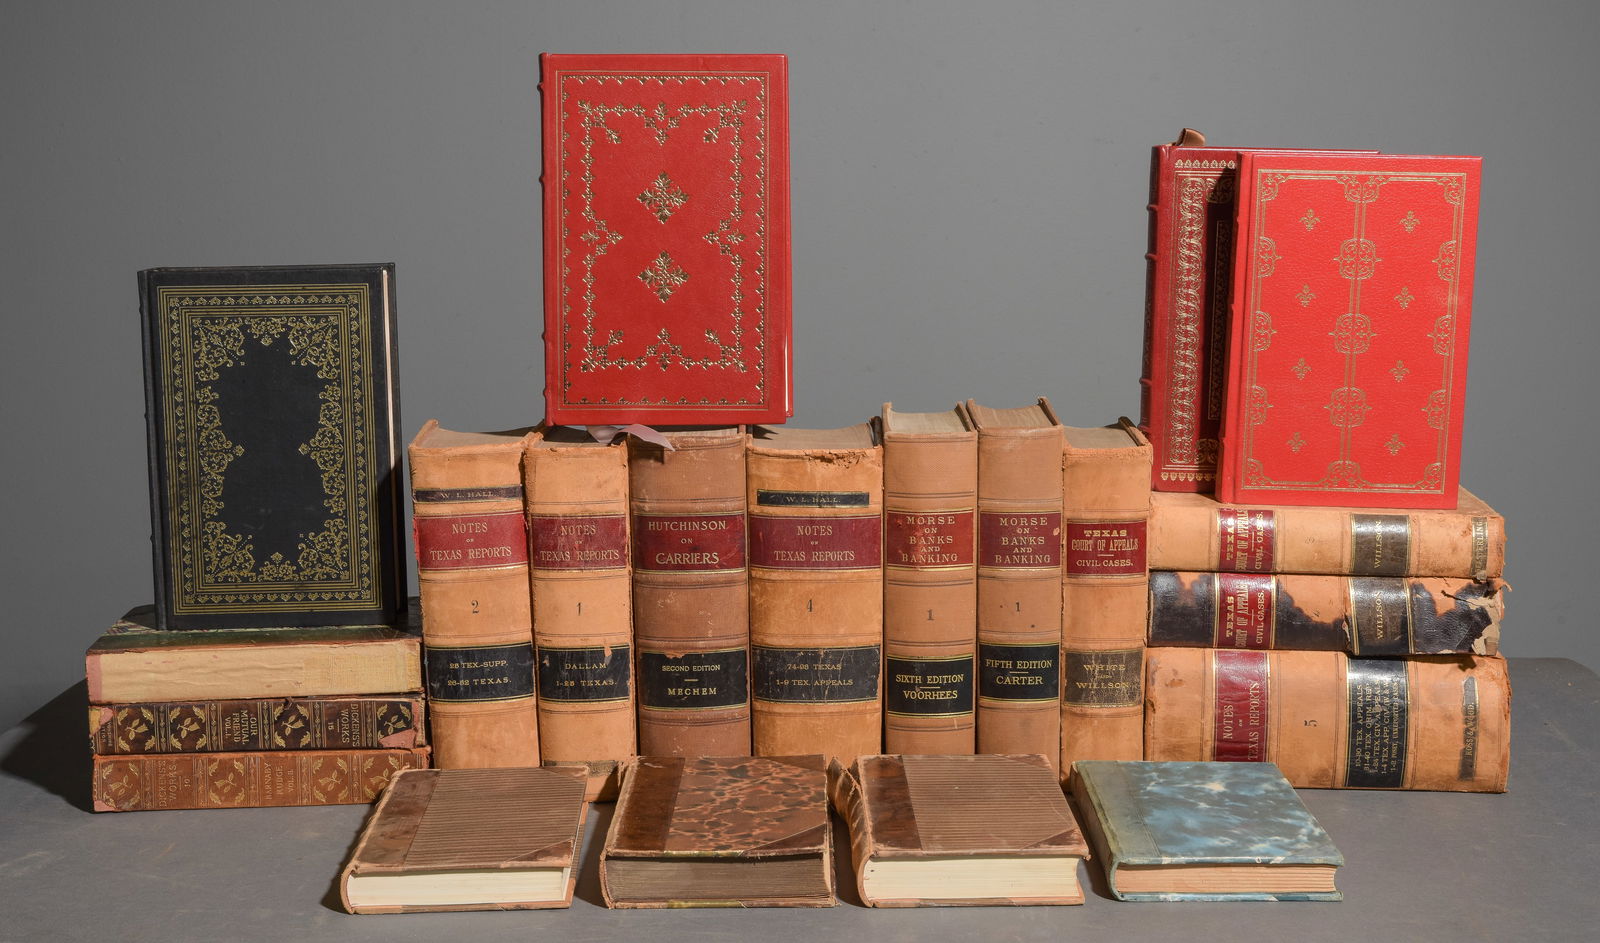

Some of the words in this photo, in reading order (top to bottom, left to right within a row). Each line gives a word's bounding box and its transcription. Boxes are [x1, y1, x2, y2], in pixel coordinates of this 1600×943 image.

[648, 520, 726, 532] HUTCHINSON
[906, 516, 955, 525] MORSE
[1000, 517, 1048, 526] MORSE
[1236, 510, 1248, 538] APPEALS
[452, 522, 488, 534] NOTES
[561, 524, 596, 536] NOTES
[797, 525, 833, 536] NOTES
[909, 536, 953, 544] BANKS
[1002, 536, 1045, 545] BANKS
[1072, 539, 1094, 551] COURT
[1097, 540, 1106, 550] OF
[1108, 538, 1138, 551] APPEALS
[1236, 540, 1248, 549] OF
[1374, 520, 1382, 568] WILLSON
[430, 550, 462, 561] TEXAS
[468, 546, 512, 559] REPORTS
[540, 550, 571, 561] TEXAS
[576, 549, 620, 560] REPORTS
[656, 552, 720, 565] CARRIERS
[774, 550, 806, 562] TEXAS
[811, 550, 855, 562] REPORTS
[902, 553, 958, 562] BANKING
[995, 554, 1051, 563] BANKING
[1255, 546, 1263, 570] CIVIL
[1235, 552, 1248, 571] COURT
[807, 599, 813, 612] 4
[1236, 584, 1248, 614] APPEALS
[1256, 590, 1264, 621] CASES.
[471, 600, 480, 614] 2
[576, 602, 582, 616] 1
[1015, 602, 1020, 612] 1
[927, 609, 934, 620] 1
[1374, 591, 1384, 639] WILLSON
[1236, 617, 1248, 626] OF
[1235, 630, 1247, 648] COURT
[1256, 622, 1264, 644] CIVIL
[986, 659, 1012, 669] FIFTH
[1016, 659, 1052, 668] EDITION
[896, 674, 922, 683] SIXTH
[927, 674, 964, 683] EDITION
[996, 676, 1043, 685] CARTER
[668, 687, 717, 696] MECHEM
[904, 690, 958, 700] VOORHEES
[1249, 682, 1260, 726] REPORTS
[233, 713, 241, 742] FRIEND
[341, 709, 350, 743] WORKS
[351, 704, 359, 747] DICKENS'S
[1223, 704, 1234, 739] NOTES
[1304, 719, 1317, 727] 5
[1248, 732, 1259, 760] TEXAS
[158, 760, 167, 807] DICKENS'S
[168, 764, 177, 801] WORKS
[264, 762, 273, 800] BARNABY
